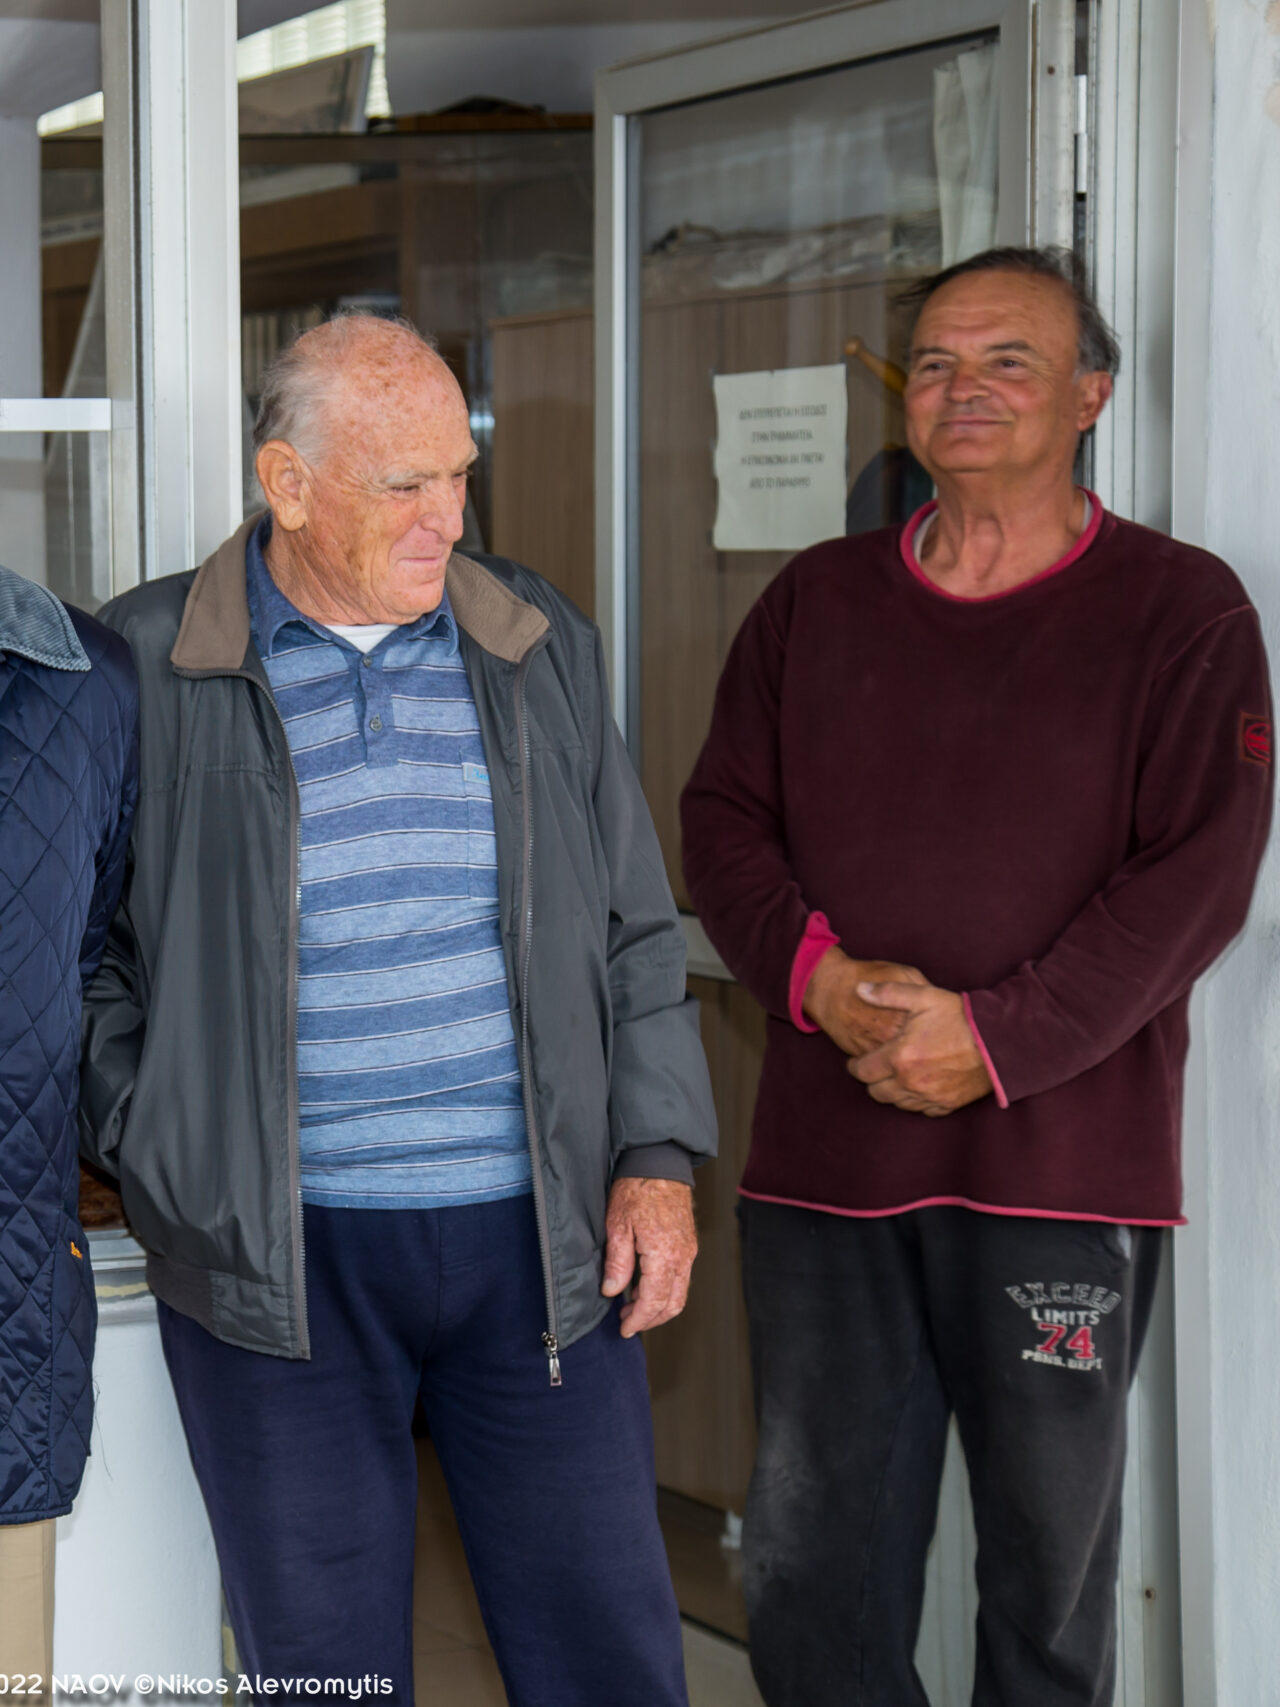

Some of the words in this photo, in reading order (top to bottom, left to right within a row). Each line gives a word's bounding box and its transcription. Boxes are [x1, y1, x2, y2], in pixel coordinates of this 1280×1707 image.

[1005, 1282, 1122, 1314] EXCEED
[1031, 1308, 1100, 1325] LIMITS
[1036, 1323, 1095, 1359] 74
